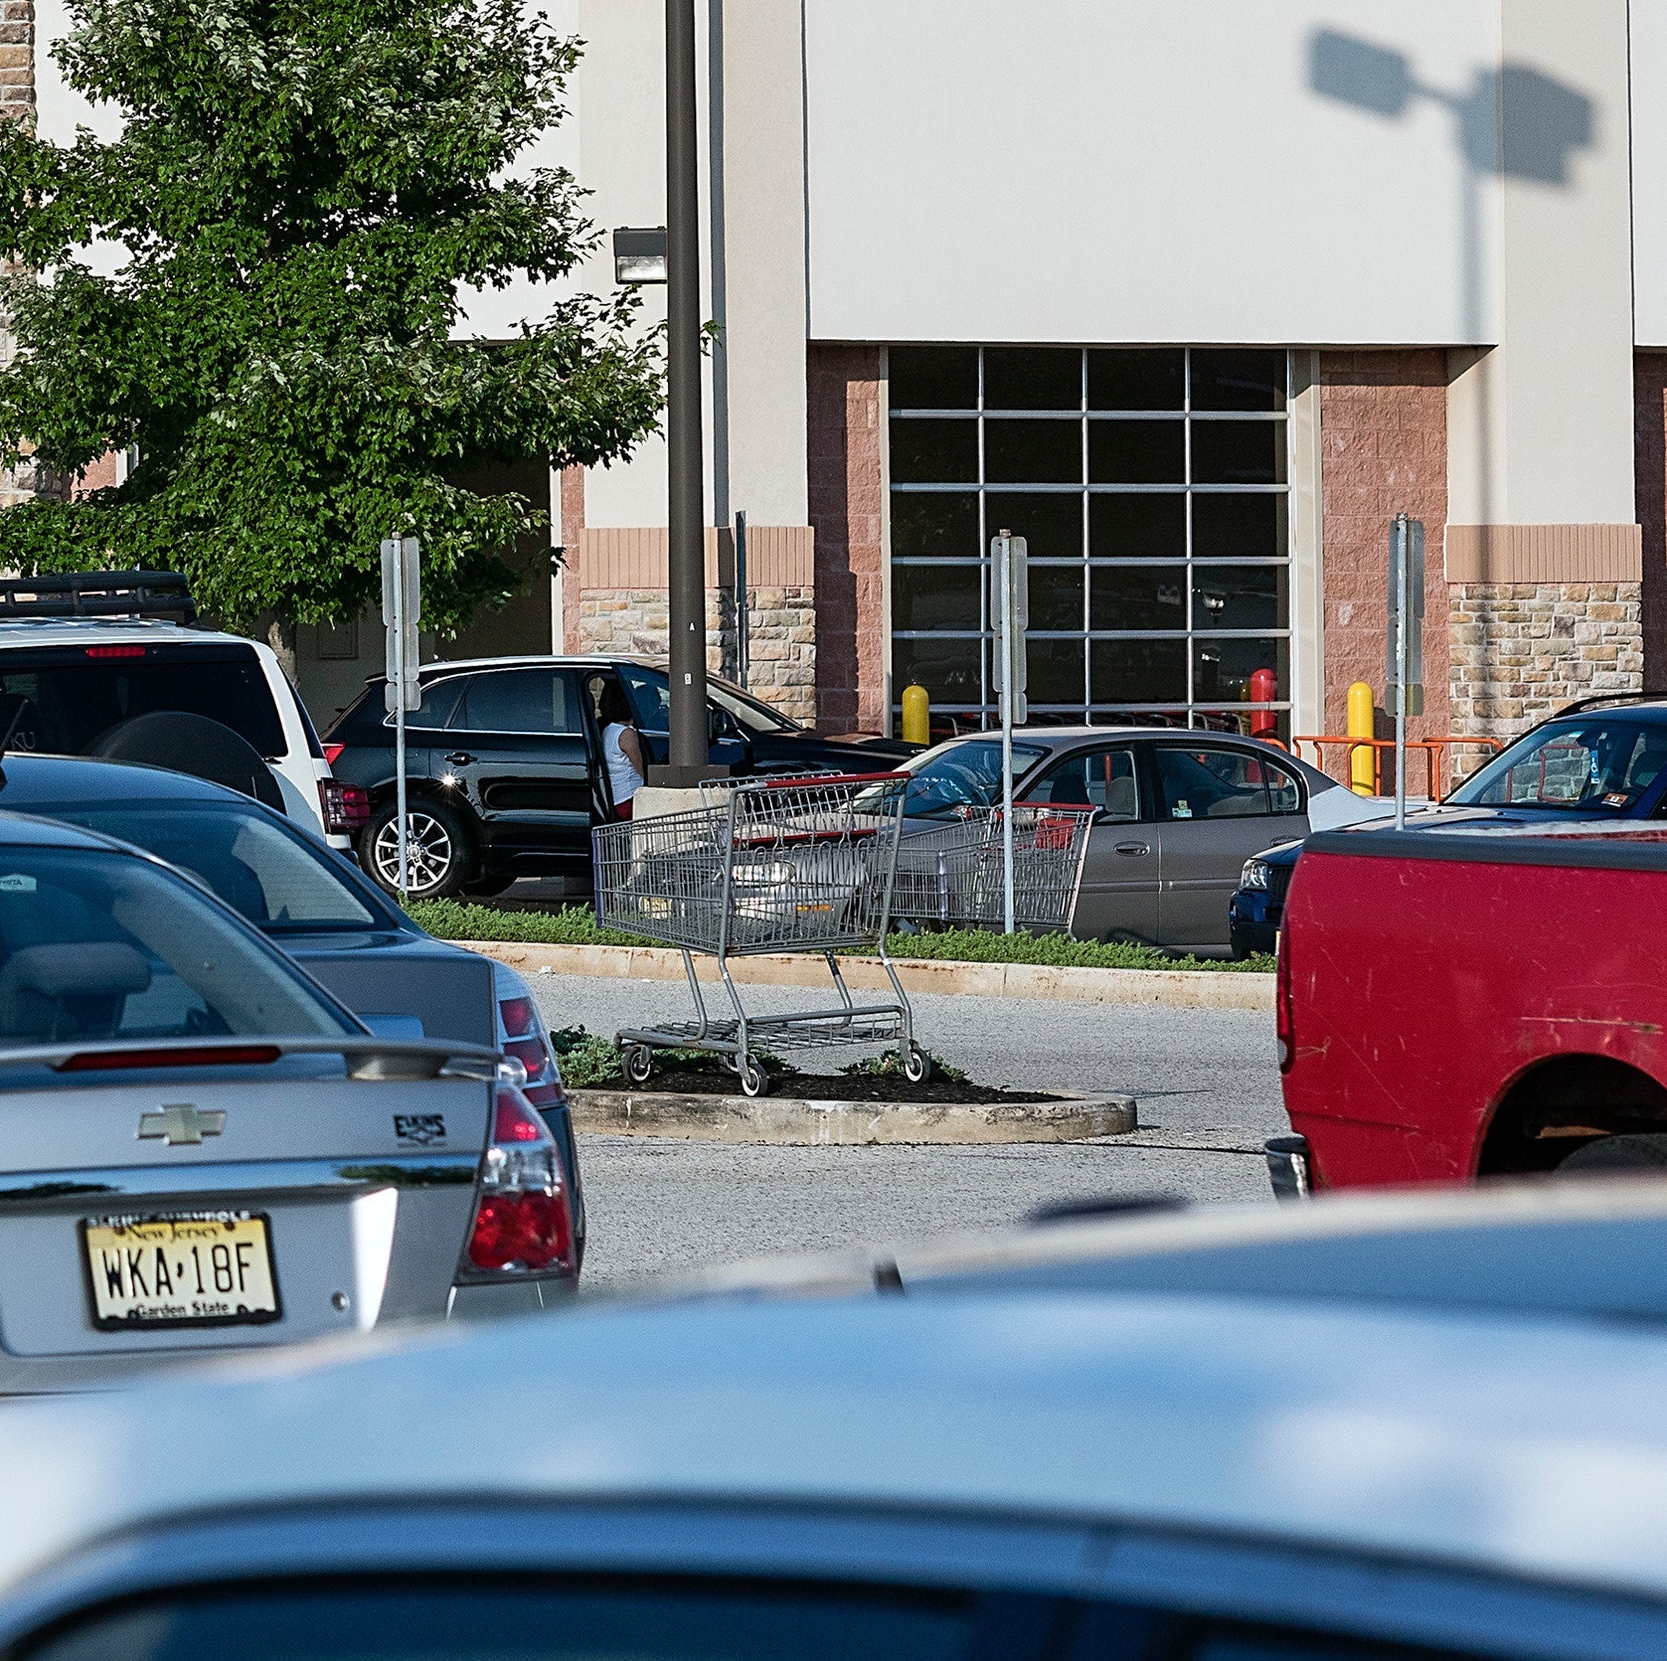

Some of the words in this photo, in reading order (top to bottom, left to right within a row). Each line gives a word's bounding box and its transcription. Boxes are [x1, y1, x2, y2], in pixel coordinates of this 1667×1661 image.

[129, 1226, 164, 1240] New
[170, 1226, 221, 1243] Jersey
[137, 1304, 186, 1319] Garden
[192, 1302, 229, 1316] State
